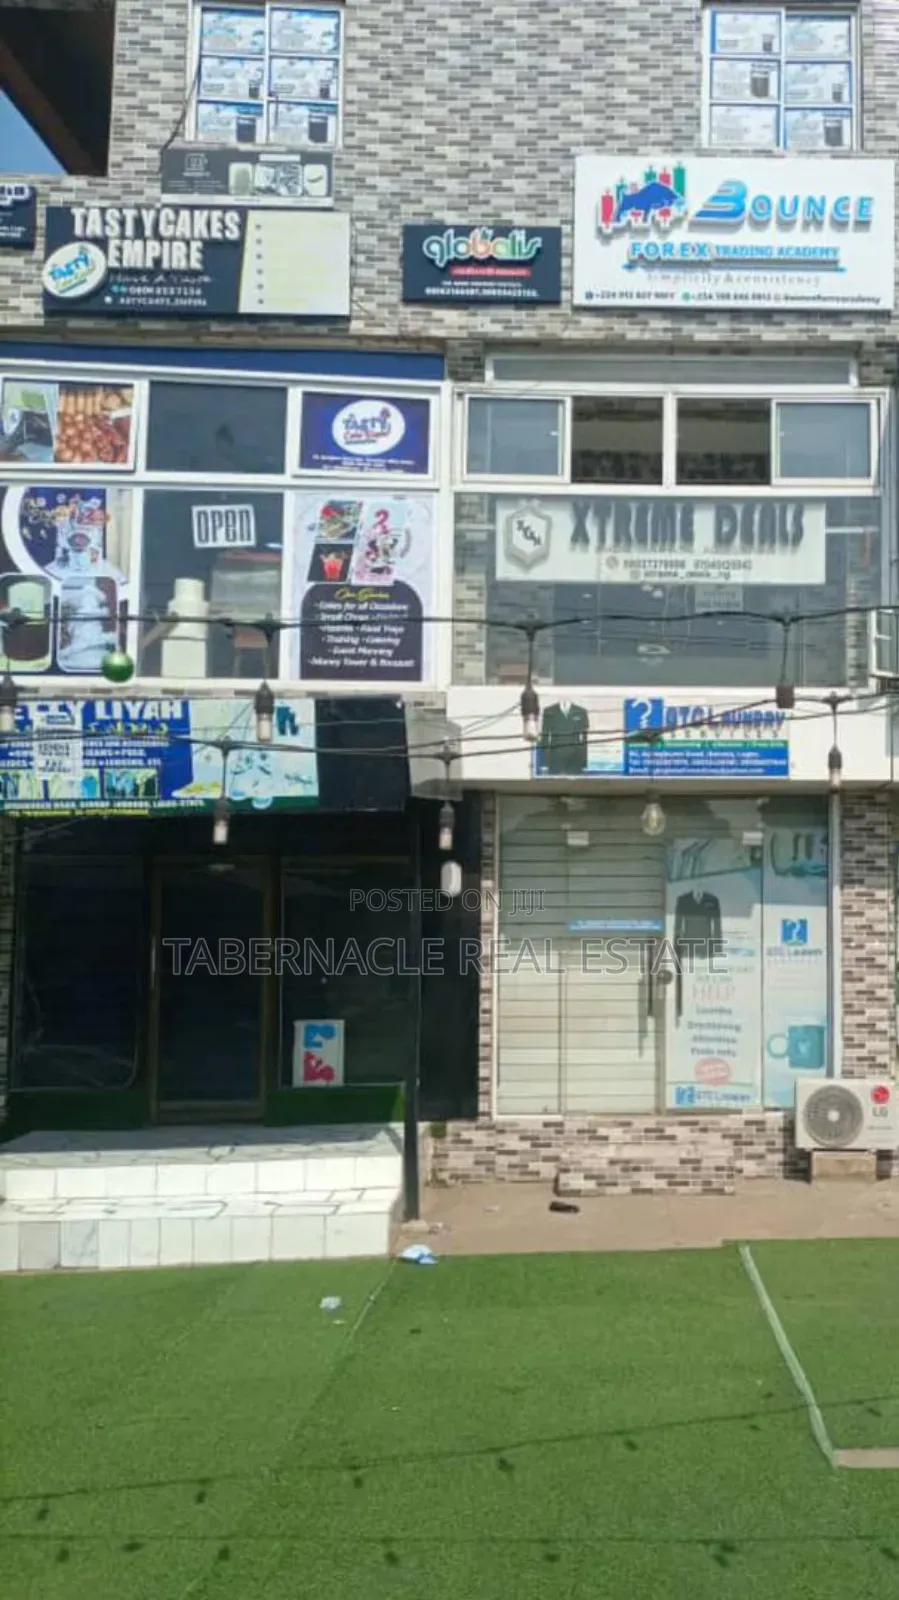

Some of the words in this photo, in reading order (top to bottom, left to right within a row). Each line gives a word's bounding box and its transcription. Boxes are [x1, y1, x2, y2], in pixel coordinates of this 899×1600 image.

[694, 179, 873, 220] BOUNCE
[71, 208, 240, 240] TASTYCAKES
[108, 241, 204, 270] EMPIRE
[631, 241, 709, 258] FOREX
[714, 245, 773, 258] TRADING
[777, 245, 840, 259] ACADEMY
[95, 700, 183, 720] LIYAH
[871, 1107, 889, 1118] LG
